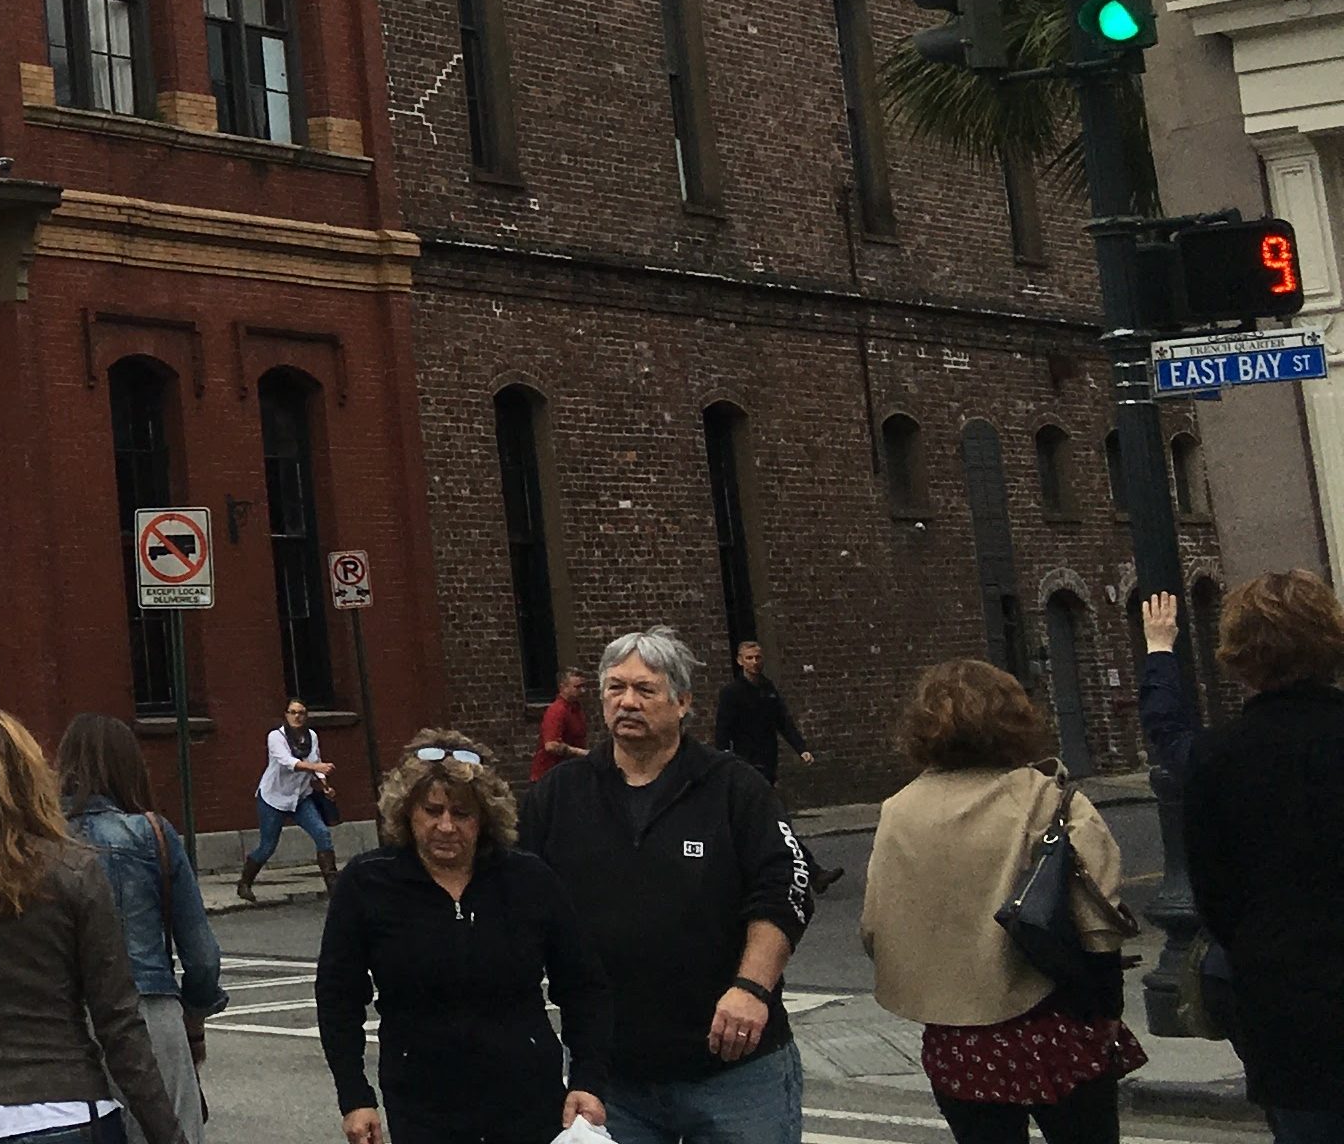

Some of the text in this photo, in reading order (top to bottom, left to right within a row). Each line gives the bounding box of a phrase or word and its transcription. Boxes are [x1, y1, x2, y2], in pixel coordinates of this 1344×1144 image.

[1262, 236, 1296, 293] 9
[1189, 337, 1285, 356] FRENCH QUARTER
[1170, 352, 1311, 387] EAST BAY ST
[146, 588, 206, 596] EXCEPT LOCAL
[153, 595, 199, 604] DELIVERIES
